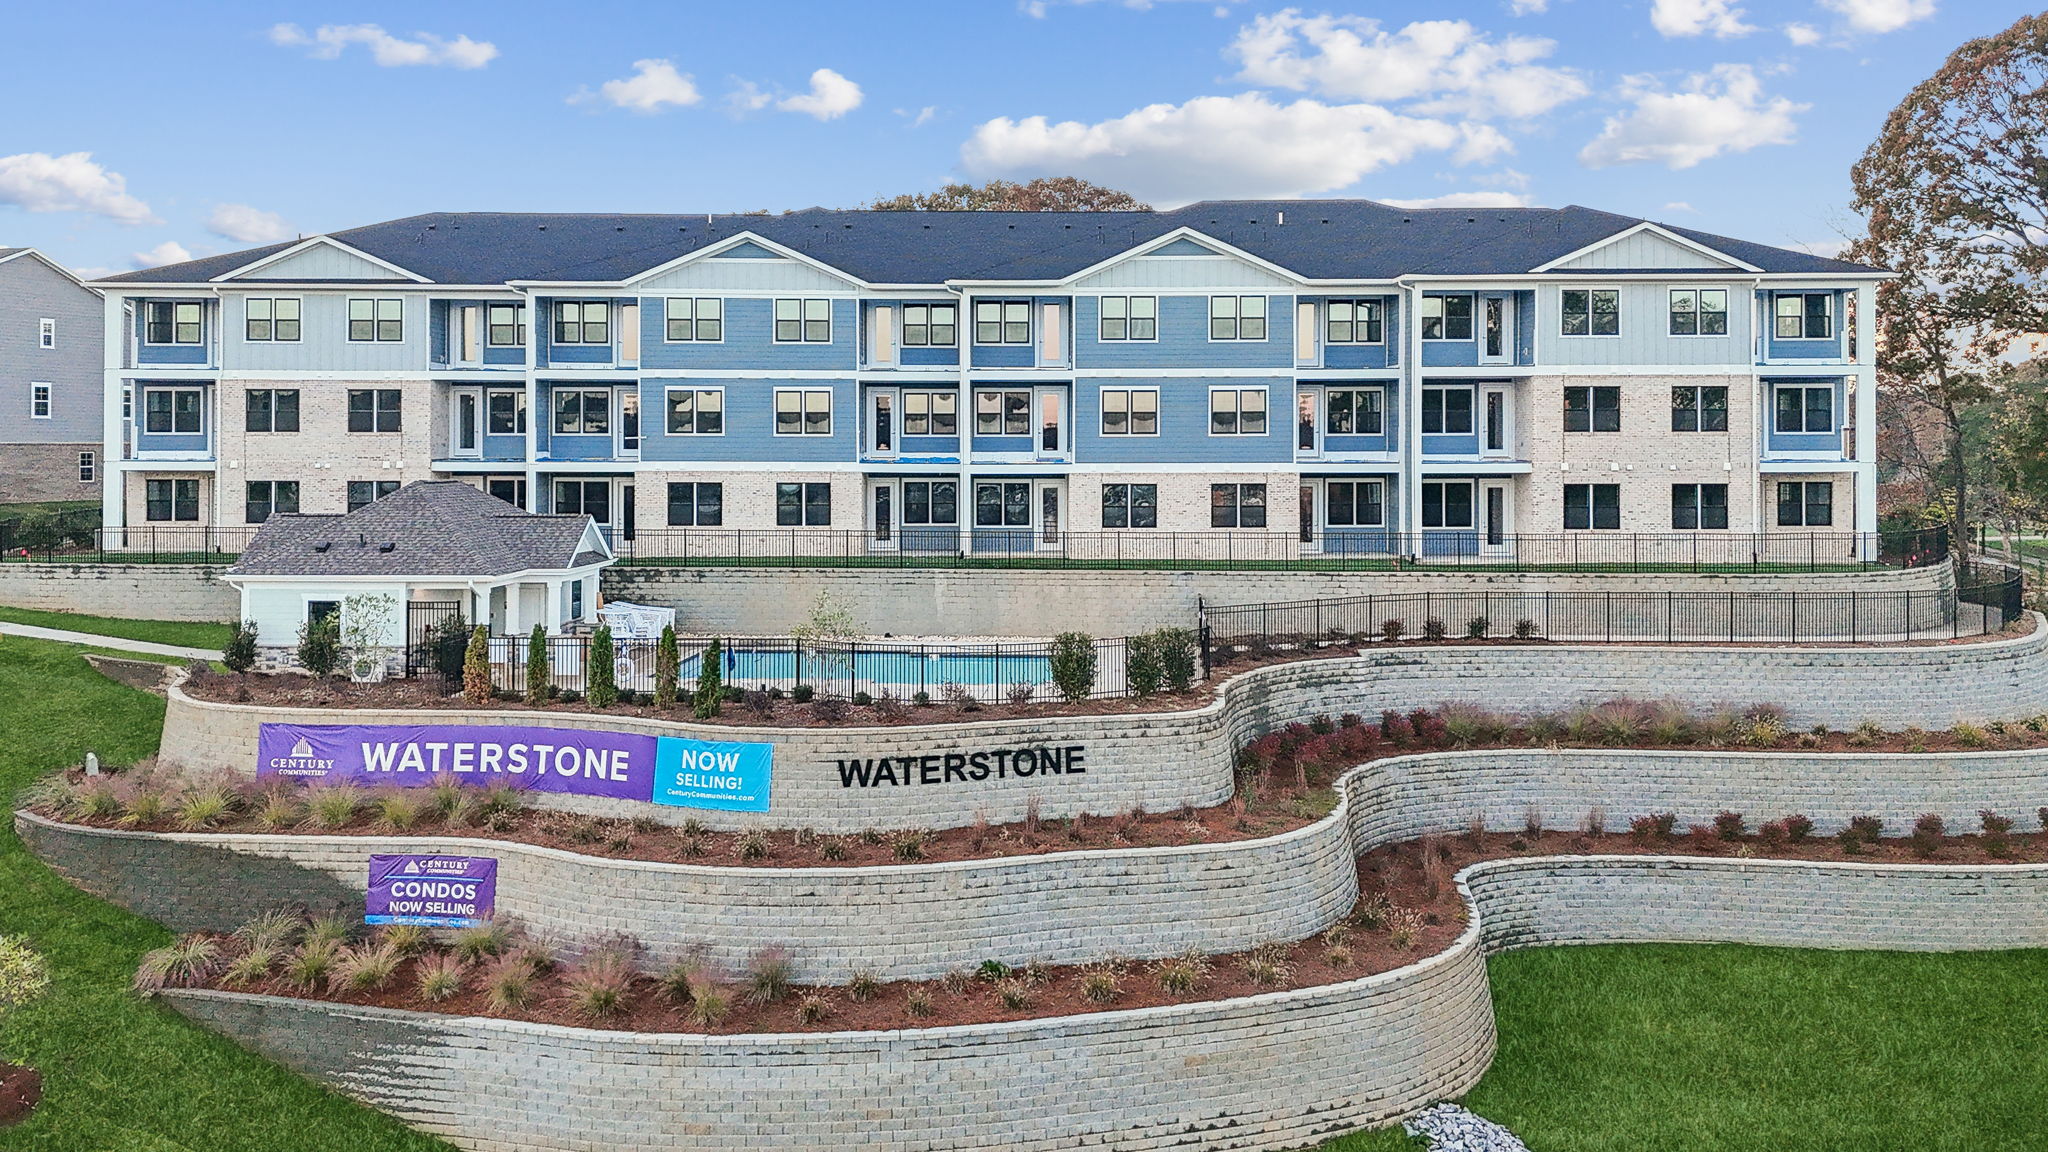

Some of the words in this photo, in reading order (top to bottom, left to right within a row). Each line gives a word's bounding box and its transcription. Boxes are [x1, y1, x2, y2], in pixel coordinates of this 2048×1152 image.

[270, 758, 335, 769] CENTURY
[361, 742, 630, 782] WATERSTONE
[681, 749, 740, 773] NOW
[837, 745, 1086, 788] WATERSTONE
[675, 772, 743, 790] SELLING!
[666, 788, 755, 801] CenturyCommunities.com
[419, 860, 470, 870] CENTURY
[390, 881, 477, 900] CONDOS
[388, 901, 424, 913] NOW
[425, 902, 475, 915] SELLING
